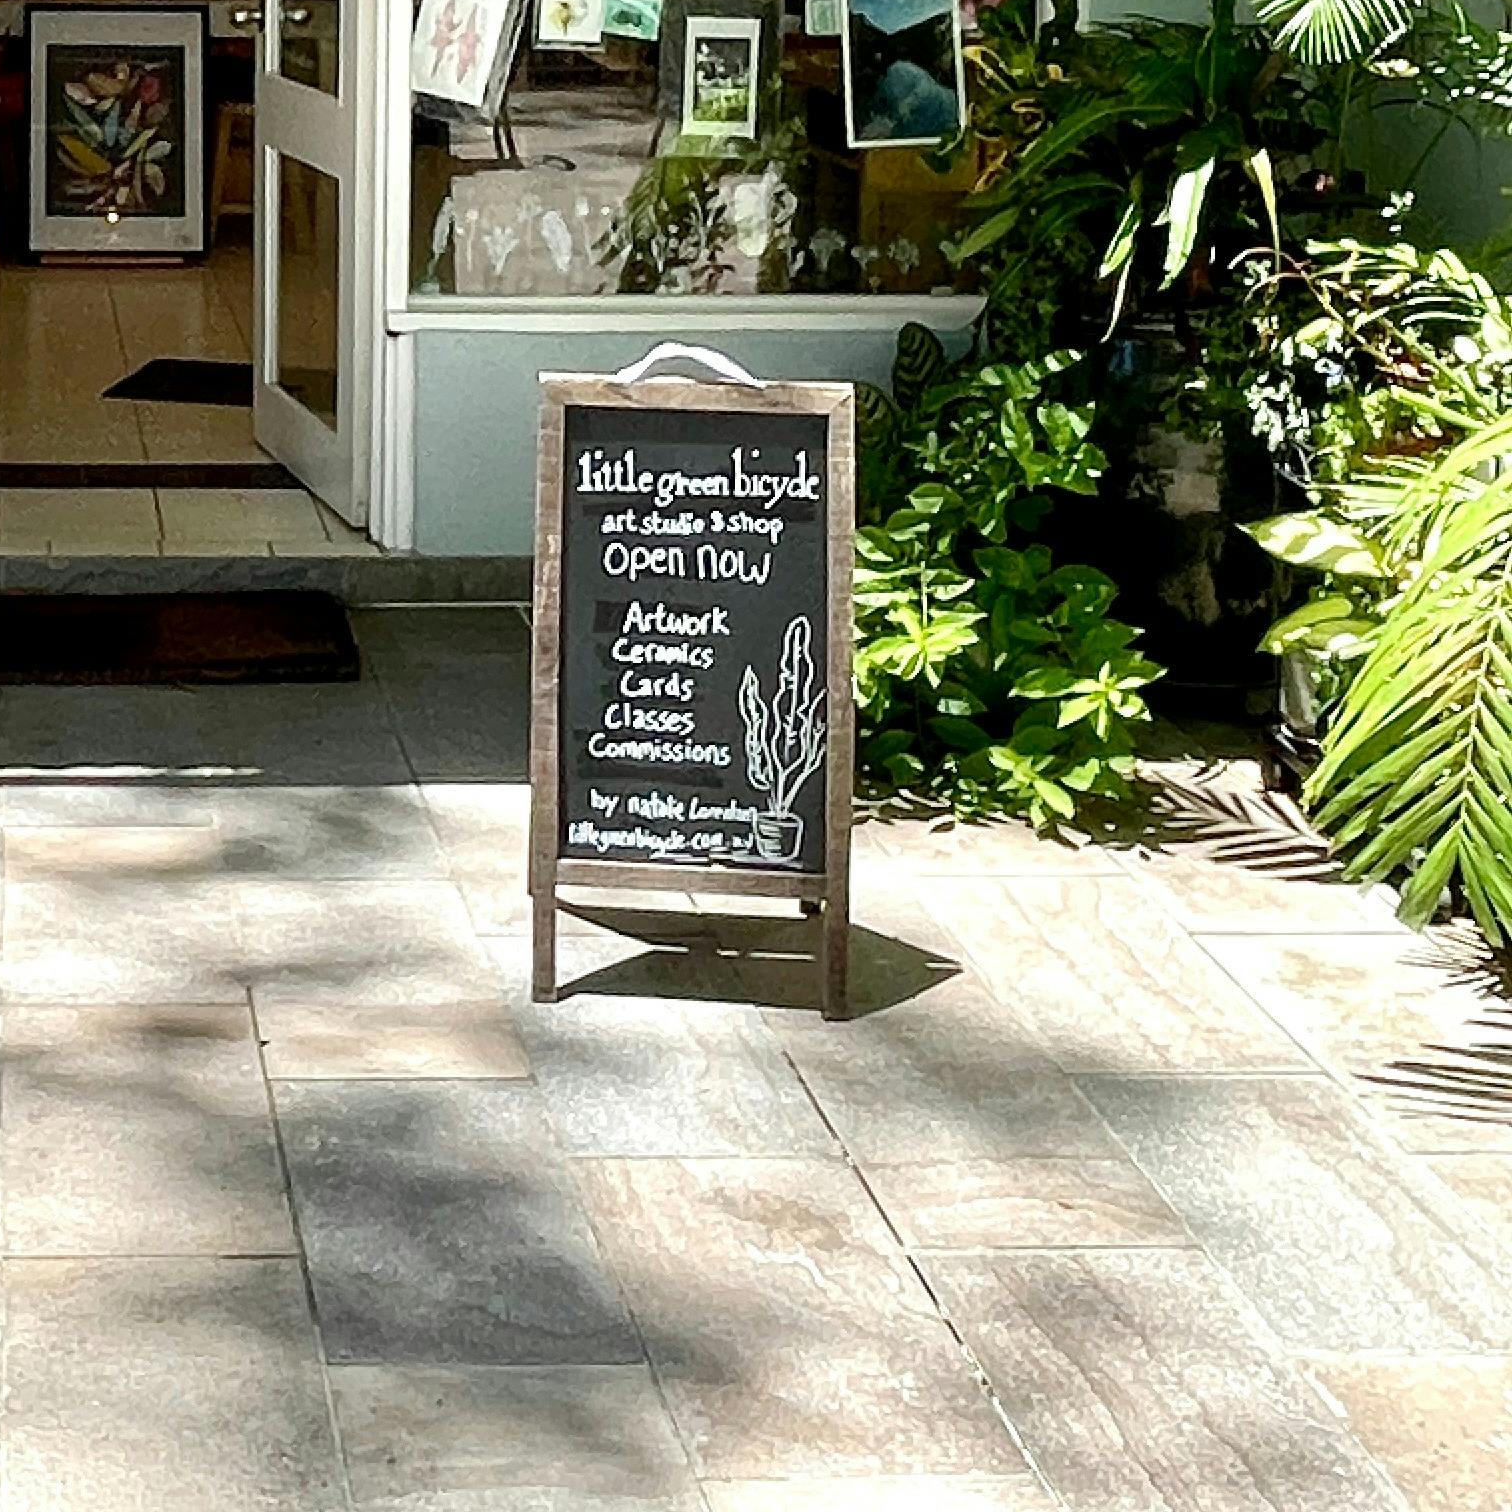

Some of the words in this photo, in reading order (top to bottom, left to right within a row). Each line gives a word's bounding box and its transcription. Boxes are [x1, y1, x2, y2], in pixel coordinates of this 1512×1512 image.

[576, 448, 654, 494] little
[654, 470, 731, 508] green
[731, 446, 821, 510] bicycle
[600, 508, 638, 534] art
[638, 510, 705, 536] studio
[726, 510, 785, 545] shop
[622, 600, 731, 636] Artwork
[610, 637, 715, 670] Ceramics
[619, 669, 696, 702] Cards
[603, 701, 696, 736] Classes
[587, 732, 732, 766] Commissions
[590, 788, 620, 818] by
